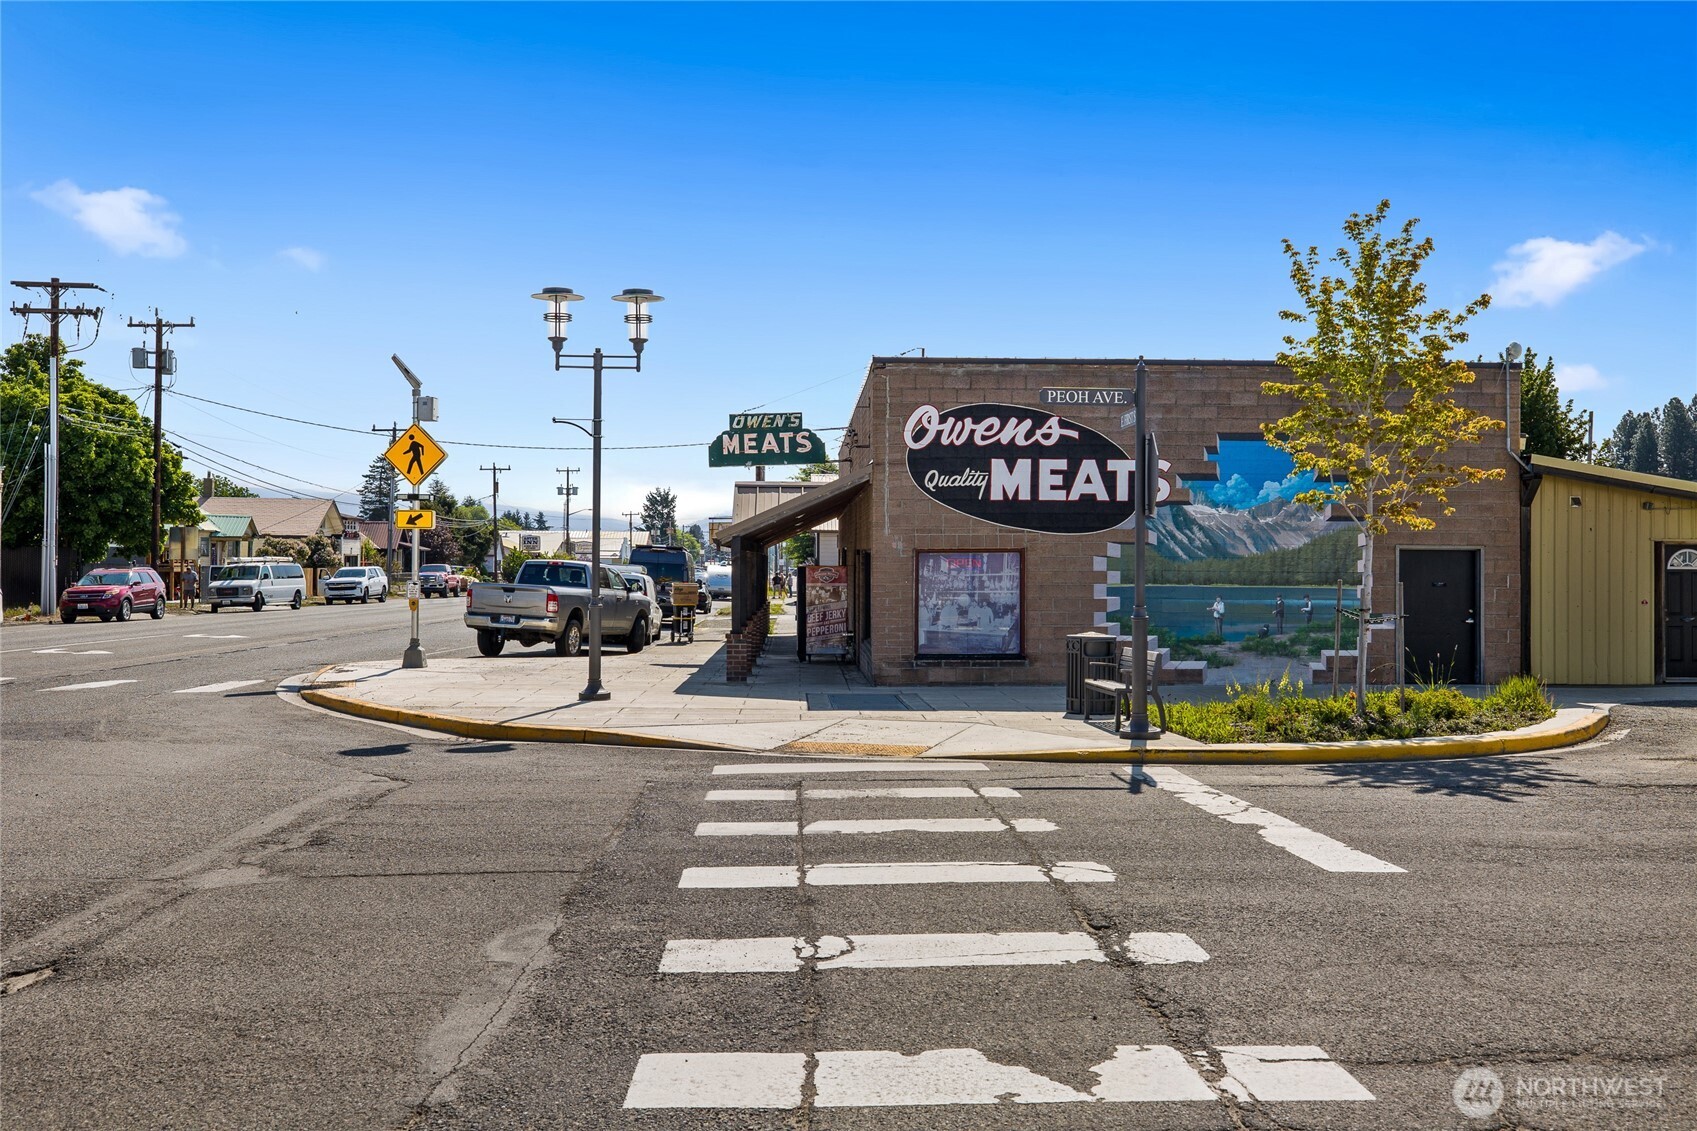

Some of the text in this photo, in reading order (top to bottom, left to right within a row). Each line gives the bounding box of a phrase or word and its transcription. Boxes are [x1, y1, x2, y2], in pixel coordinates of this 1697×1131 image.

[1047, 390, 1127, 404] PEOH AVE.
[732, 413, 801, 429] OWEN'S
[904, 404, 1079, 450] Owens
[722, 431, 812, 455] MEATS
[924, 467, 989, 500] Quality
[807, 611, 824, 623] BEEF
[825, 608, 847, 620] JERKY
[806, 622, 847, 637] PEPPERONI
